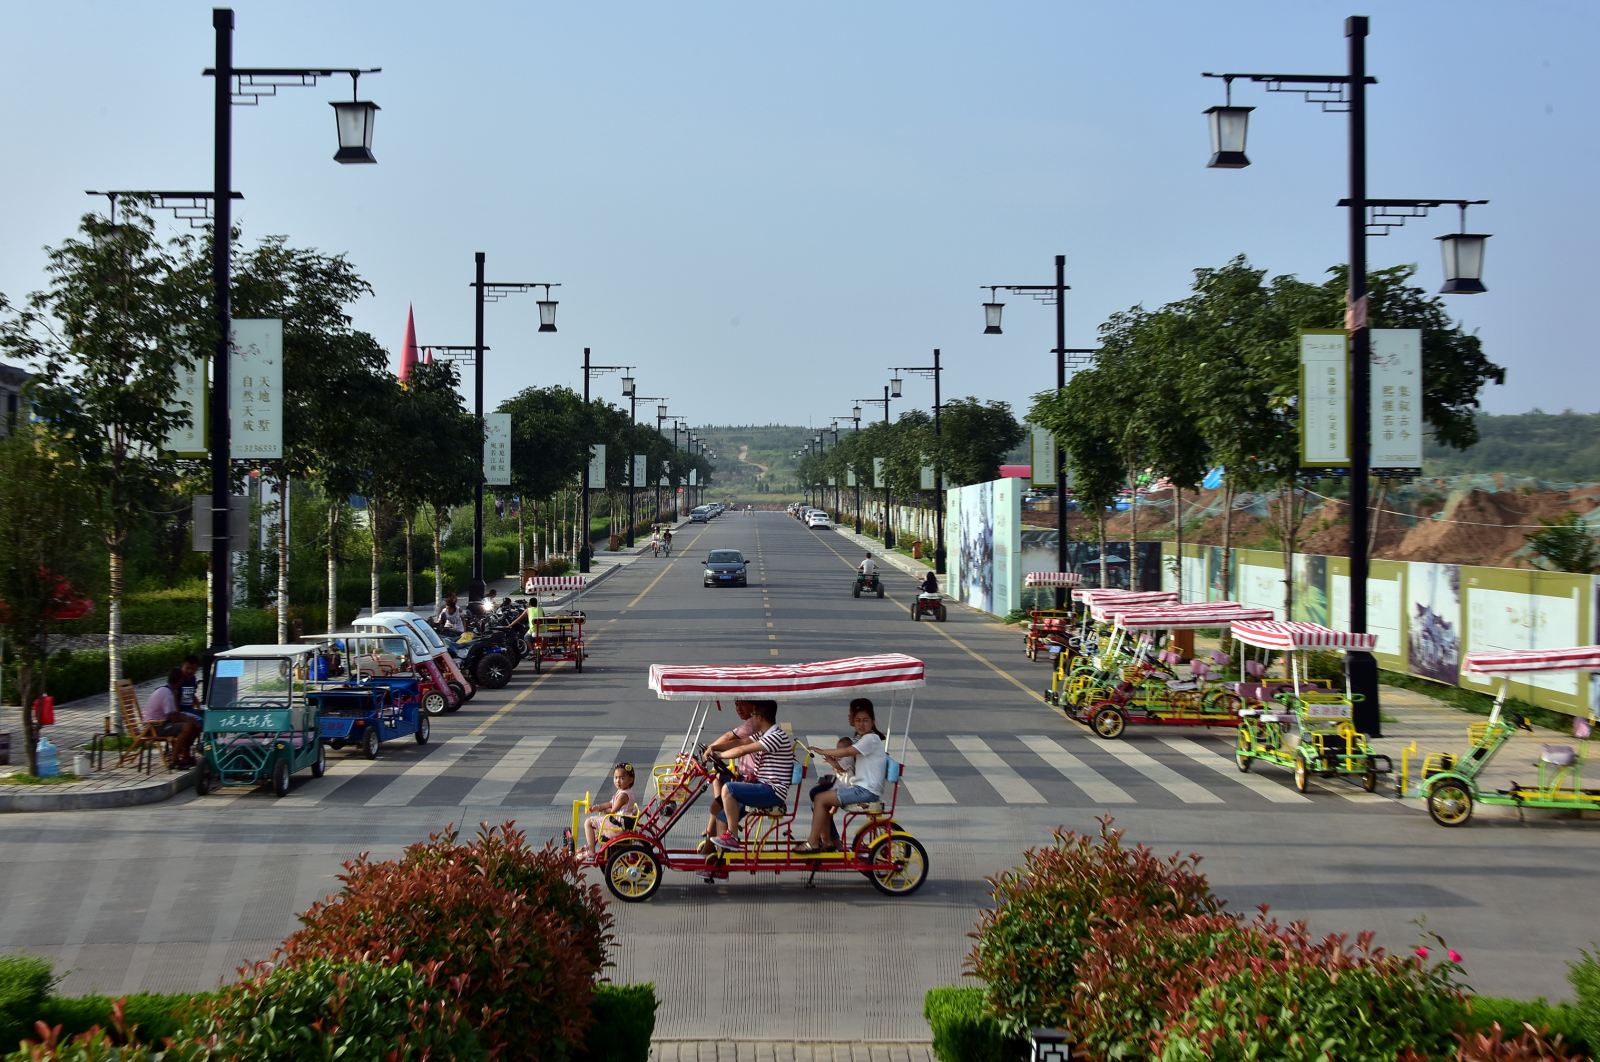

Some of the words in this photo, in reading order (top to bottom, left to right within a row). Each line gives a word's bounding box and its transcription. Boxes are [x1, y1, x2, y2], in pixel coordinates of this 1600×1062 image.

[243, 376, 255, 432] 自然天成
[258, 376, 271, 432] 天地一墅
